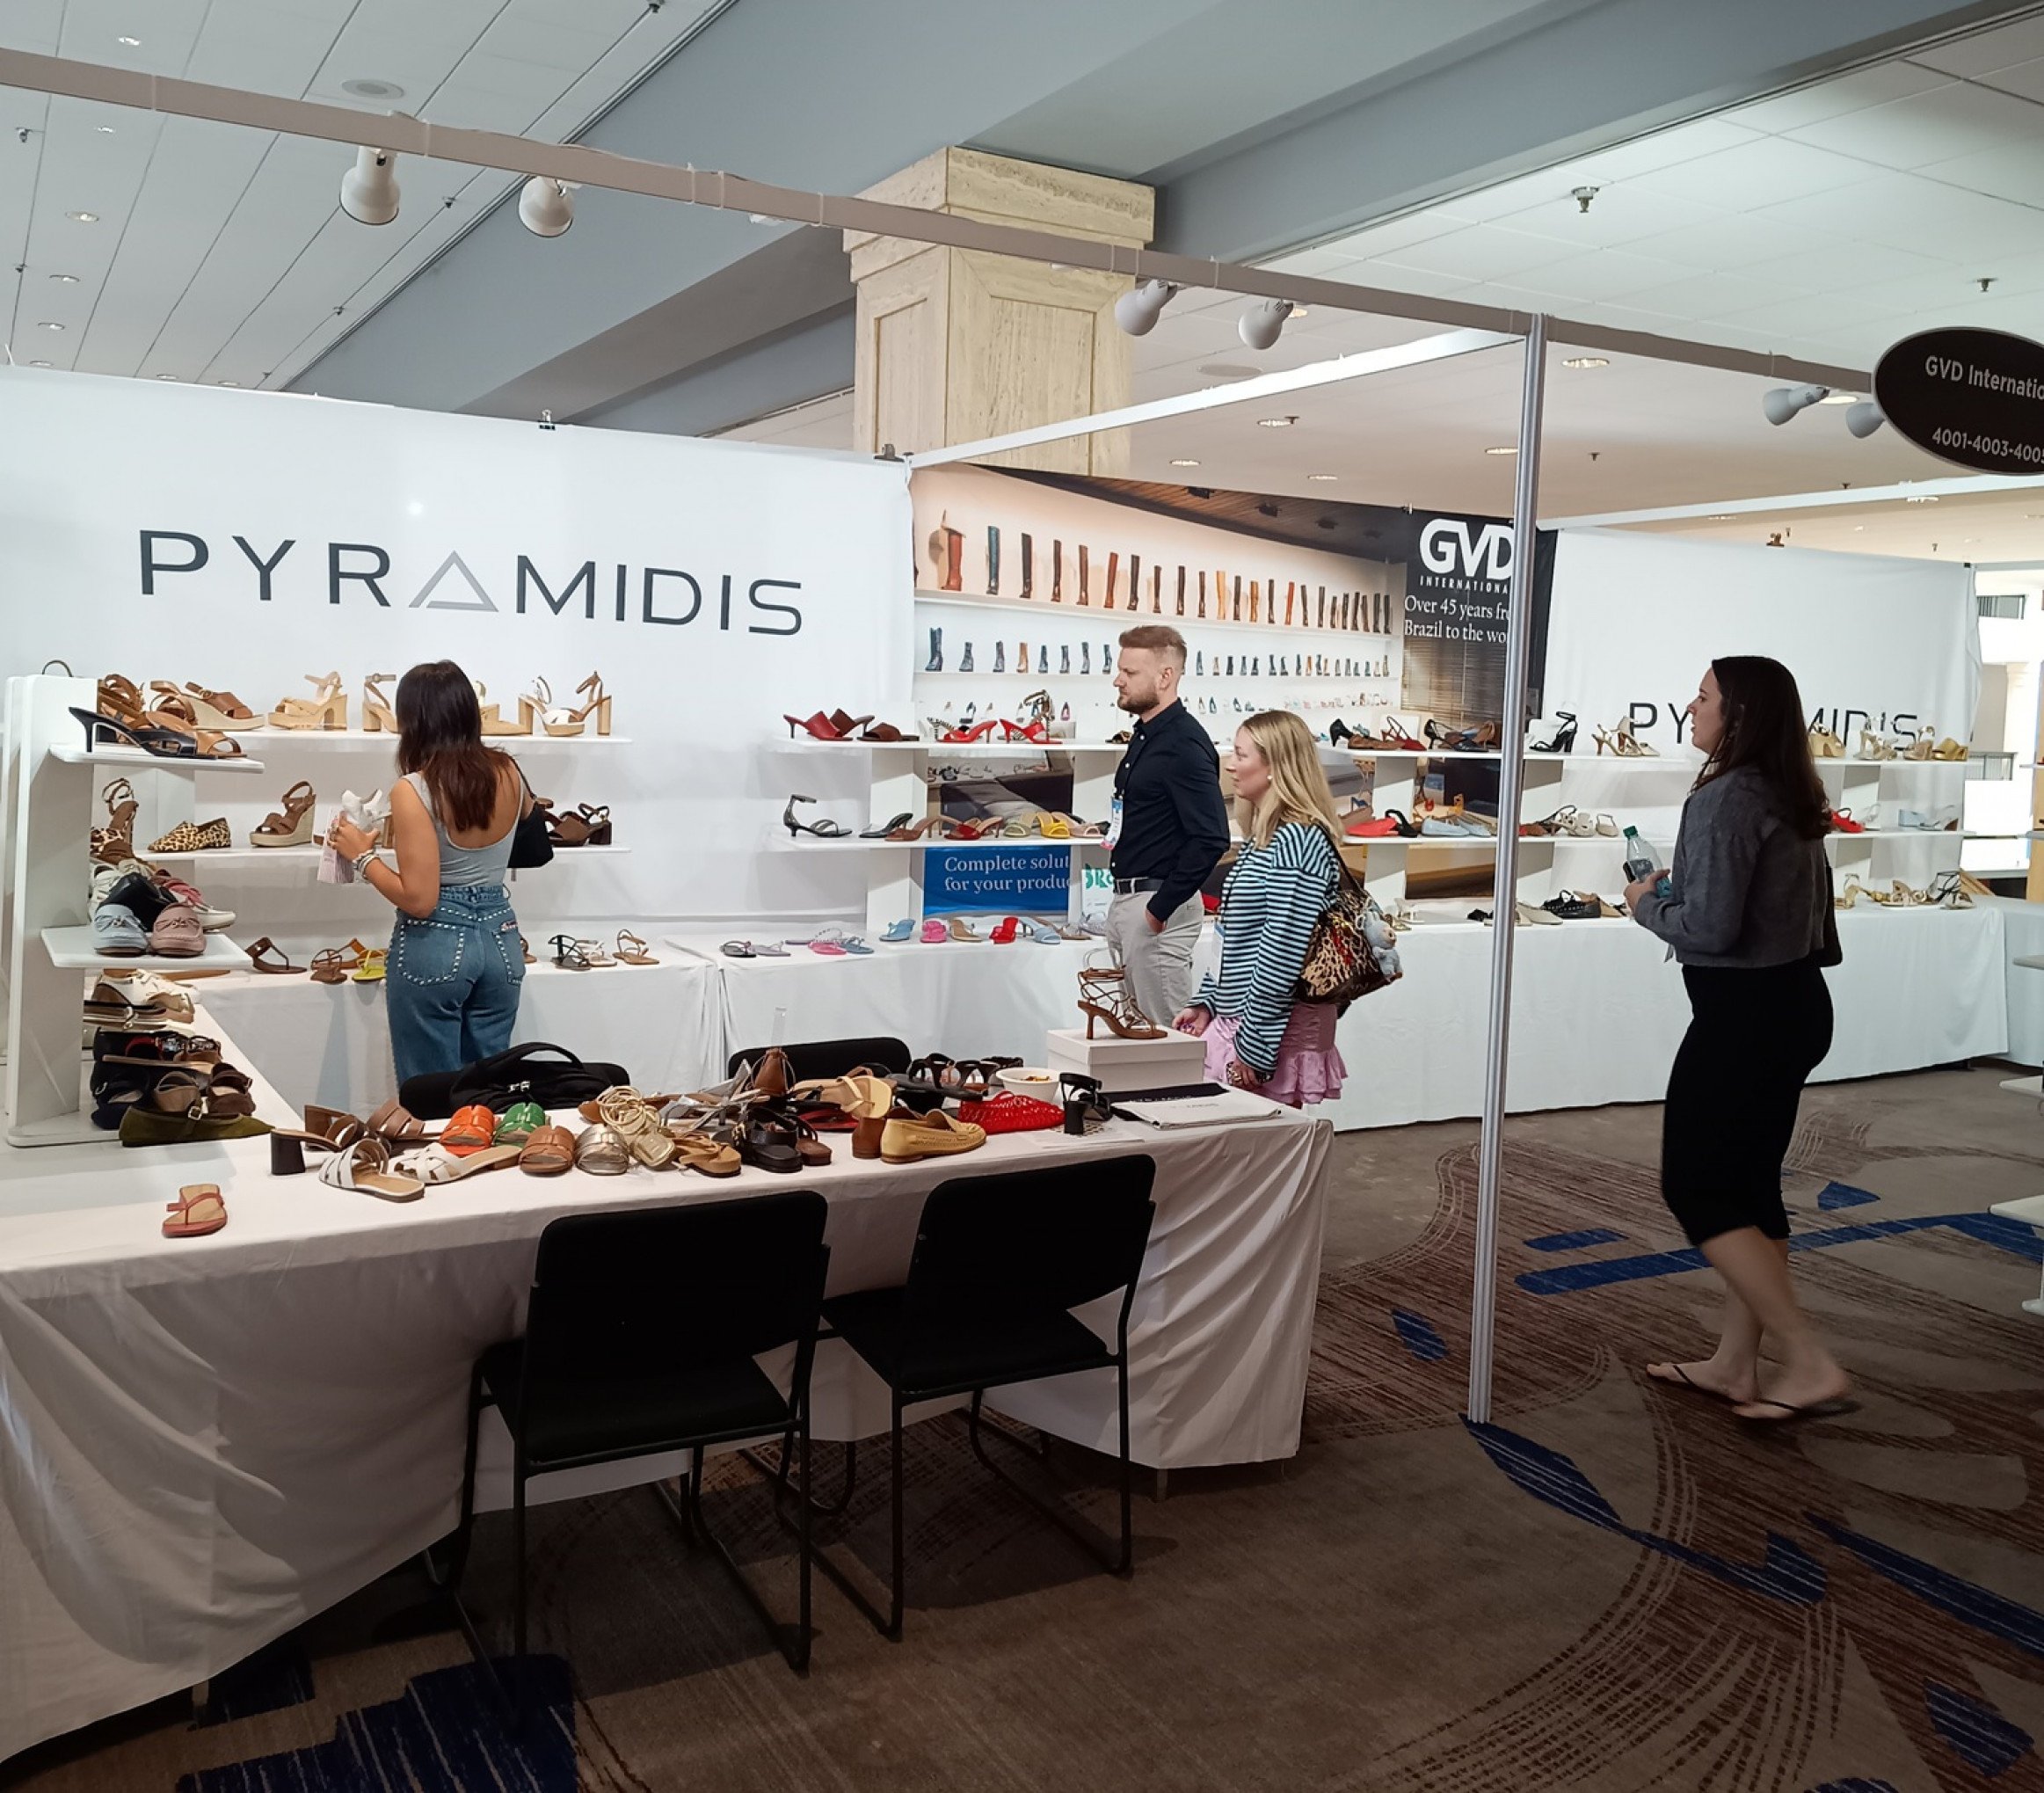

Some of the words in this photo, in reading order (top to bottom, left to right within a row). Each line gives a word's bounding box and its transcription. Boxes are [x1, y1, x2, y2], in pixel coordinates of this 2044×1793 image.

[1924, 355, 1963, 382] GVD
[1419, 518, 1514, 580] GVD
[139, 529, 802, 636] PYRAMIDIS
[1404, 594, 1437, 614] Over
[1440, 598, 1457, 615] 45
[1459, 603, 1493, 621] years
[1404, 619, 1443, 638] Brazil
[1445, 625, 1460, 639] to
[1463, 623, 1483, 641] the
[944, 854, 1027, 875] Complete
[944, 877, 970, 892] for
[973, 879, 1013, 894] your
